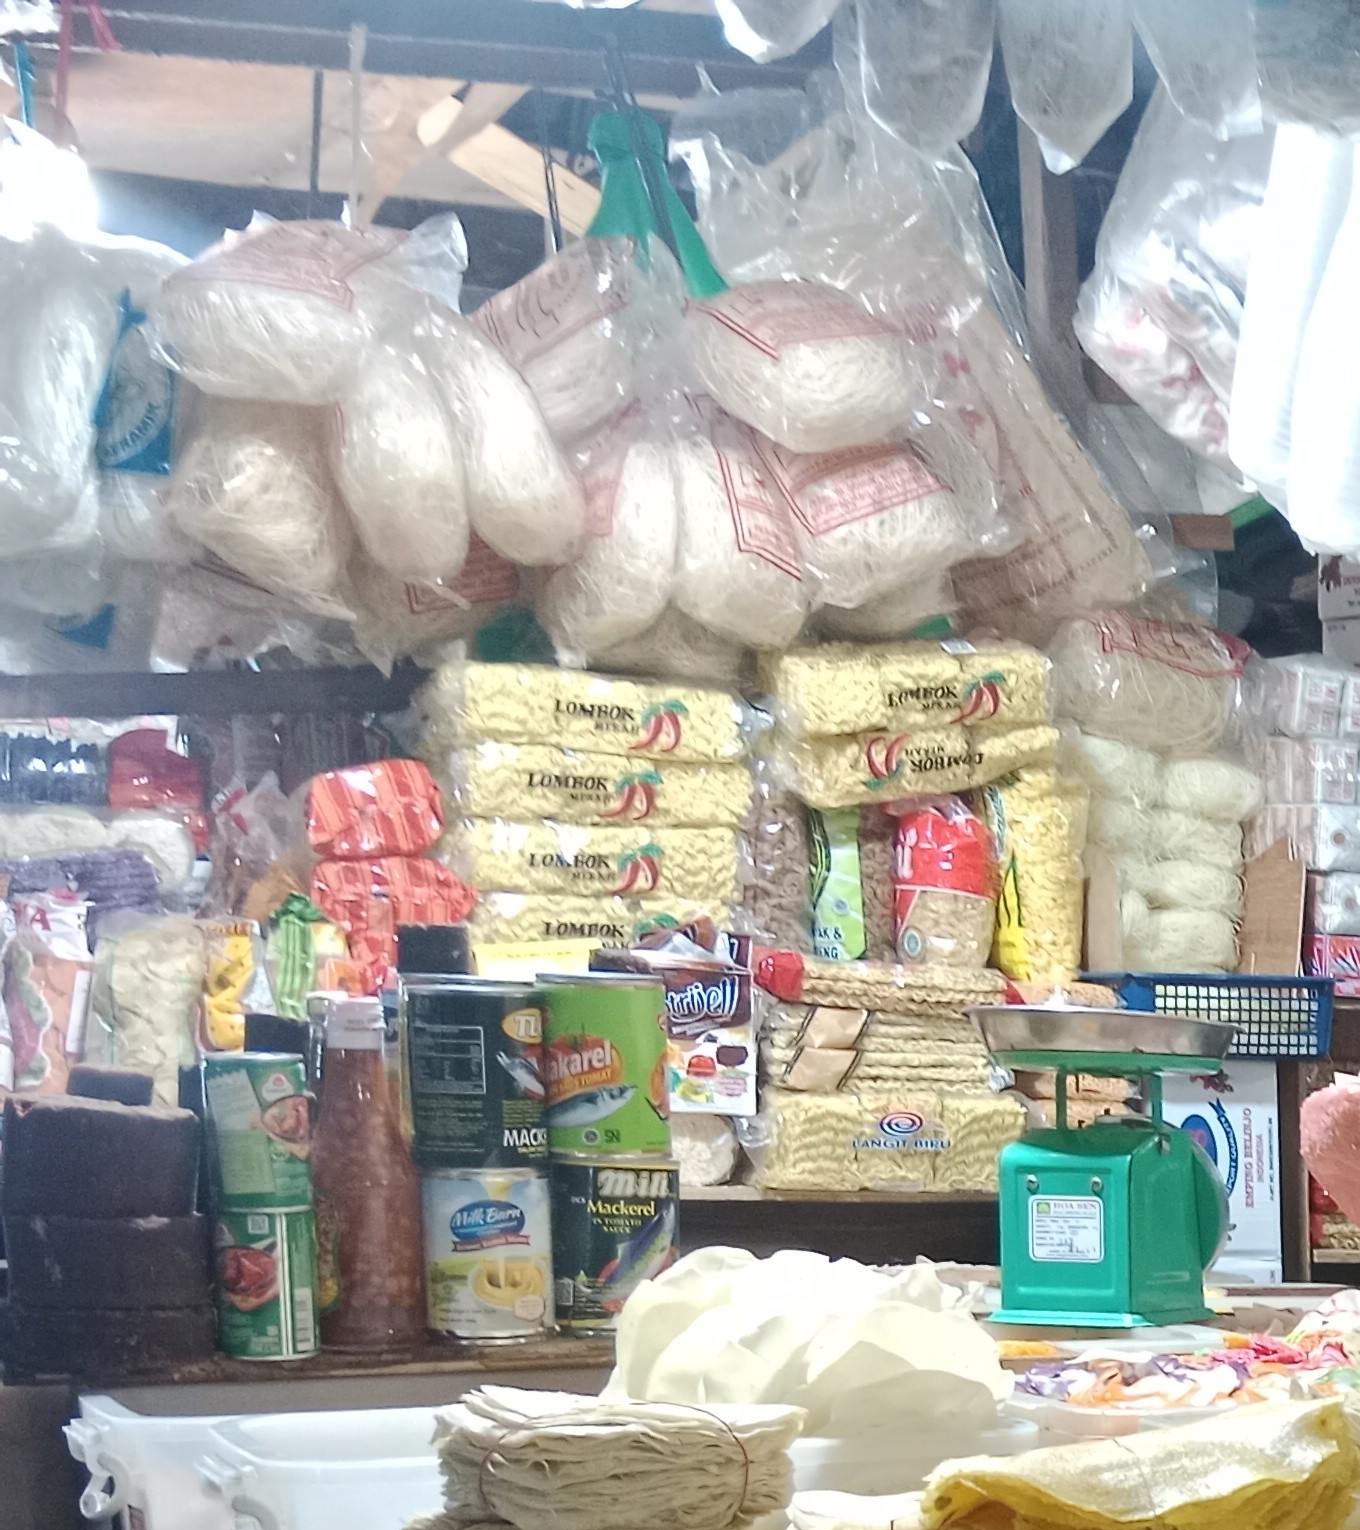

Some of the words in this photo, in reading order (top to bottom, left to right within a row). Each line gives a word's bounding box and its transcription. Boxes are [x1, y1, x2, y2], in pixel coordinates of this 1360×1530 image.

[888, 686, 957, 707] LOMBOK
[554, 699, 636, 722] LOMBOK
[527, 772, 608, 790] LOMBOK
[529, 853, 611, 869] LOMBOK
[543, 920, 626, 938] LOMBOK
[548, 1039, 613, 1082] akarel
[852, 1139, 907, 1149] LANGIT
[914, 1139, 951, 1150] BIRU
[587, 1200, 655, 1217] Mackerel
[451, 1208, 484, 1229] Milk
